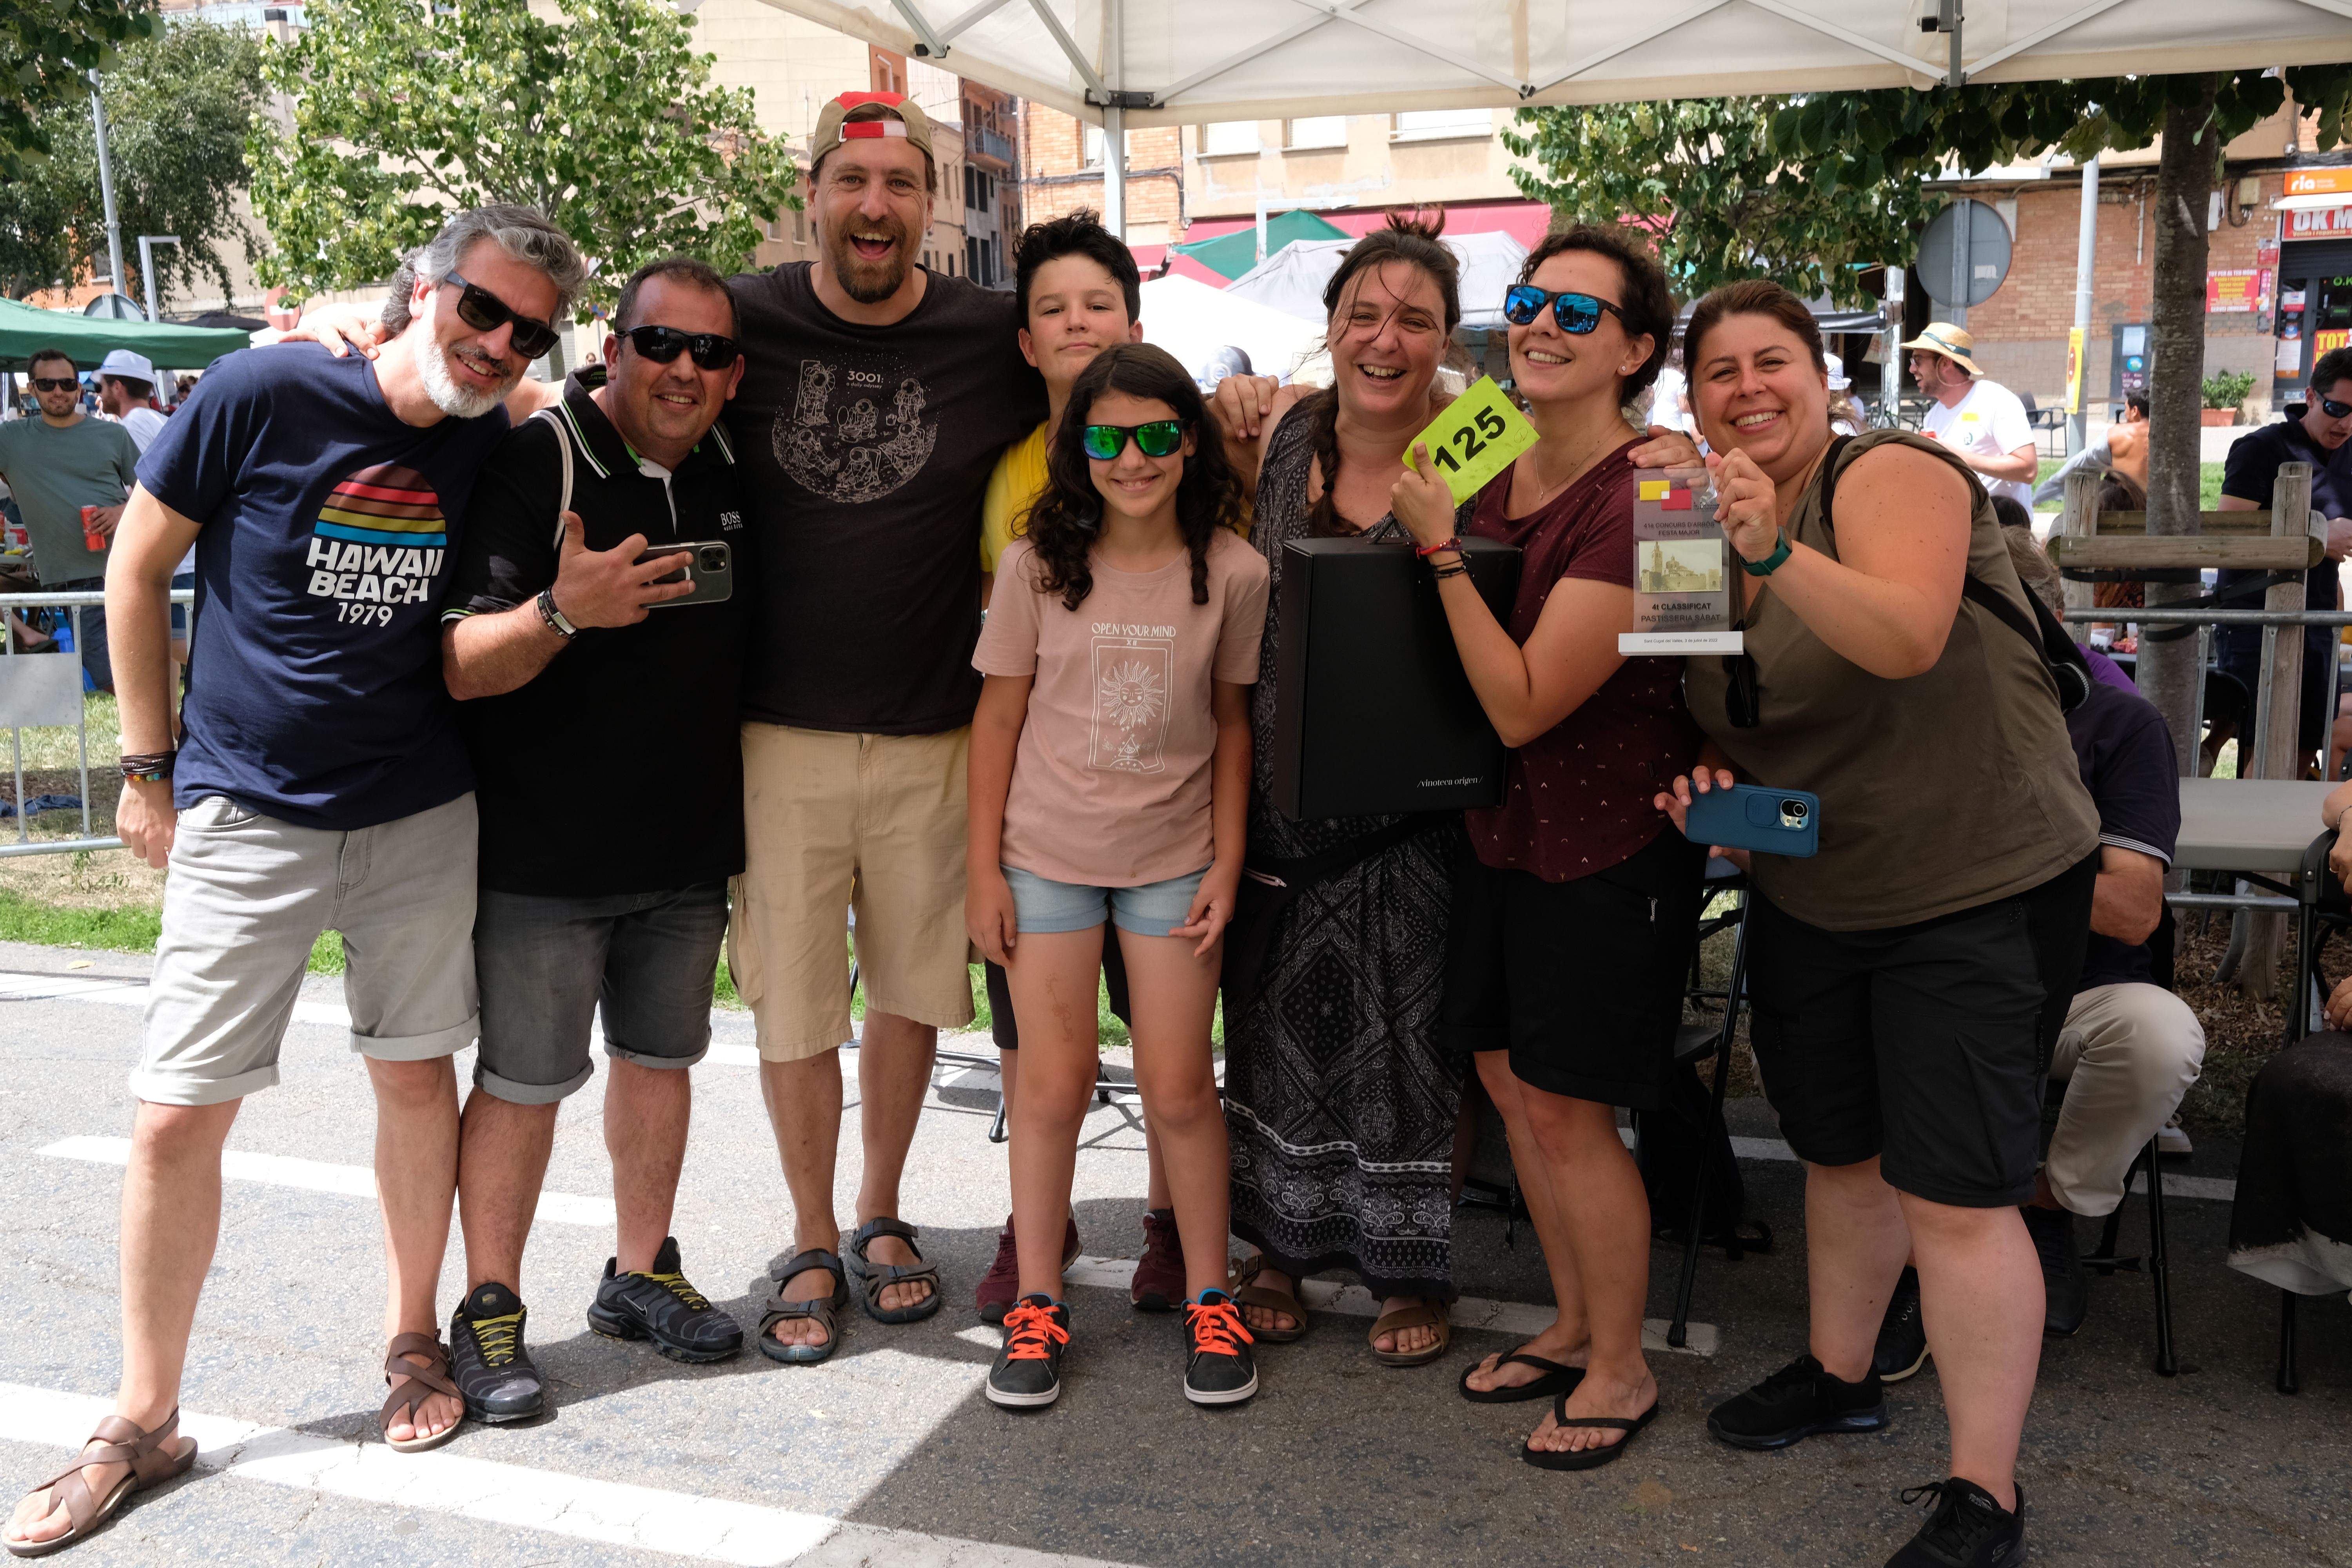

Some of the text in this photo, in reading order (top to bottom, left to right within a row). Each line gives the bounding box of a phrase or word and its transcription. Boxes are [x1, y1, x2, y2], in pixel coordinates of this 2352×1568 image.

[2291, 175, 2315, 191] ria
[2293, 211, 2328, 231] OK
[2317, 333, 2347, 350] TOT
[848, 370, 884, 383] 3001:
[1434, 405, 1506, 473] 125
[720, 511, 740, 526] BOSS
[306, 537, 444, 577] HAWAII
[307, 569, 429, 604] BEACH
[338, 602, 392, 627] 1979
[1092, 622, 1176, 637] OPEN YOUR MIND
